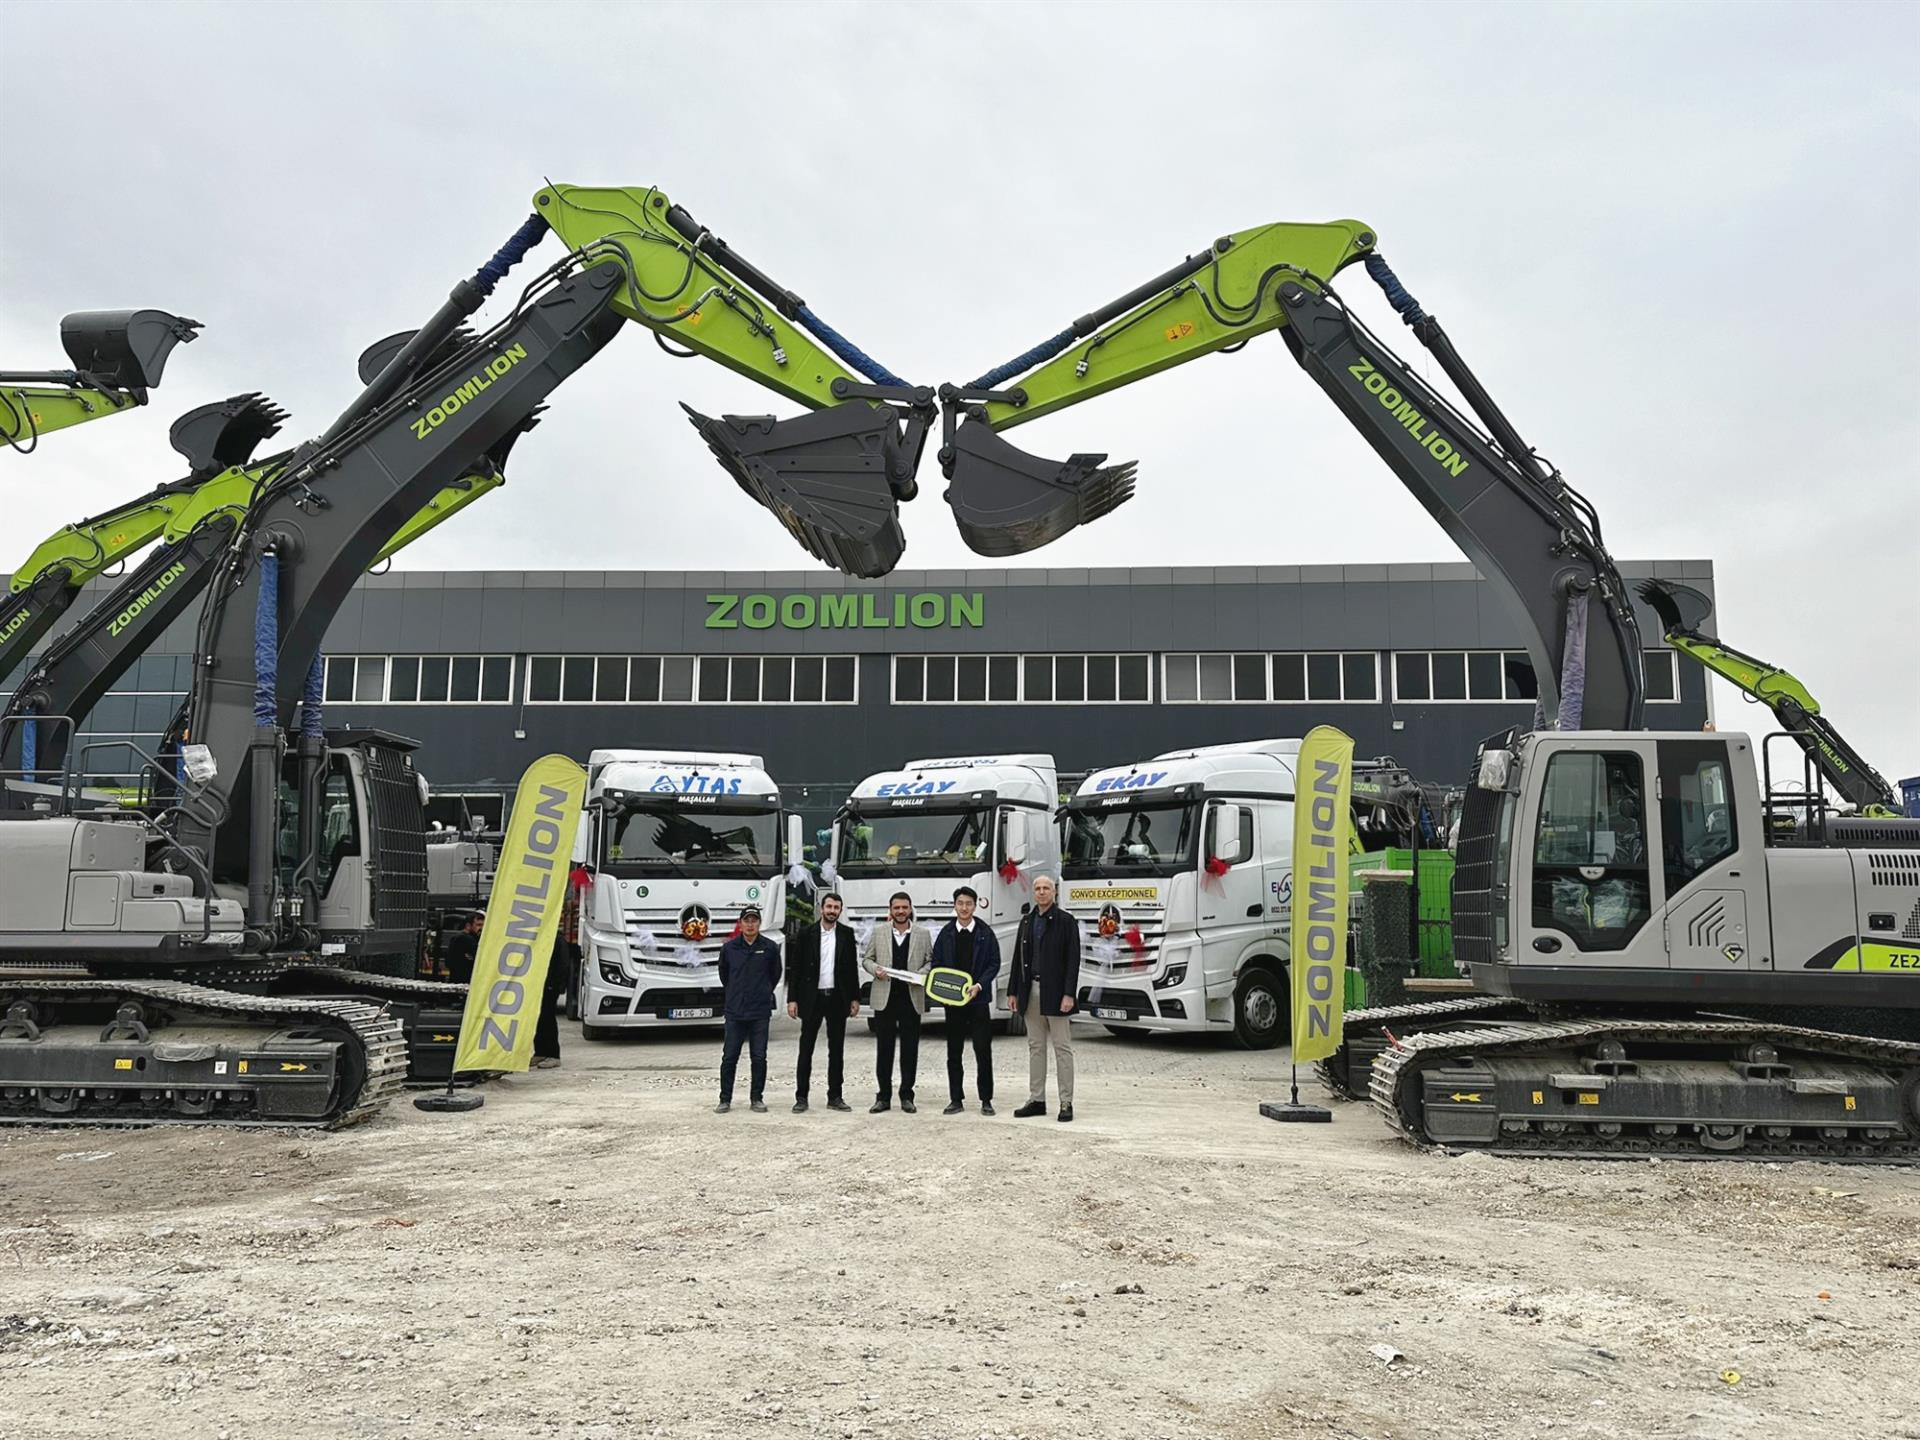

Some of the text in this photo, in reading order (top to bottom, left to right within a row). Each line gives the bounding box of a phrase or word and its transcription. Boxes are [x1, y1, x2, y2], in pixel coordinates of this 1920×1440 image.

[410, 342, 528, 440] ZOOMLION
[1348, 356, 1470, 477] ZOOMLION
[0, 608, 31, 646] LION
[106, 561, 187, 637] ZOOMLION
[705, 593, 984, 629] ZOOMLION
[876, 781, 957, 796] EKAY
[1095, 771, 1169, 792] EKAY
[478, 784, 569, 1052] ZOOMLION
[1070, 888, 1156, 900] CONVOI EXCEPTIONNEL
[1306, 759, 1340, 1039] ZOOMLION
